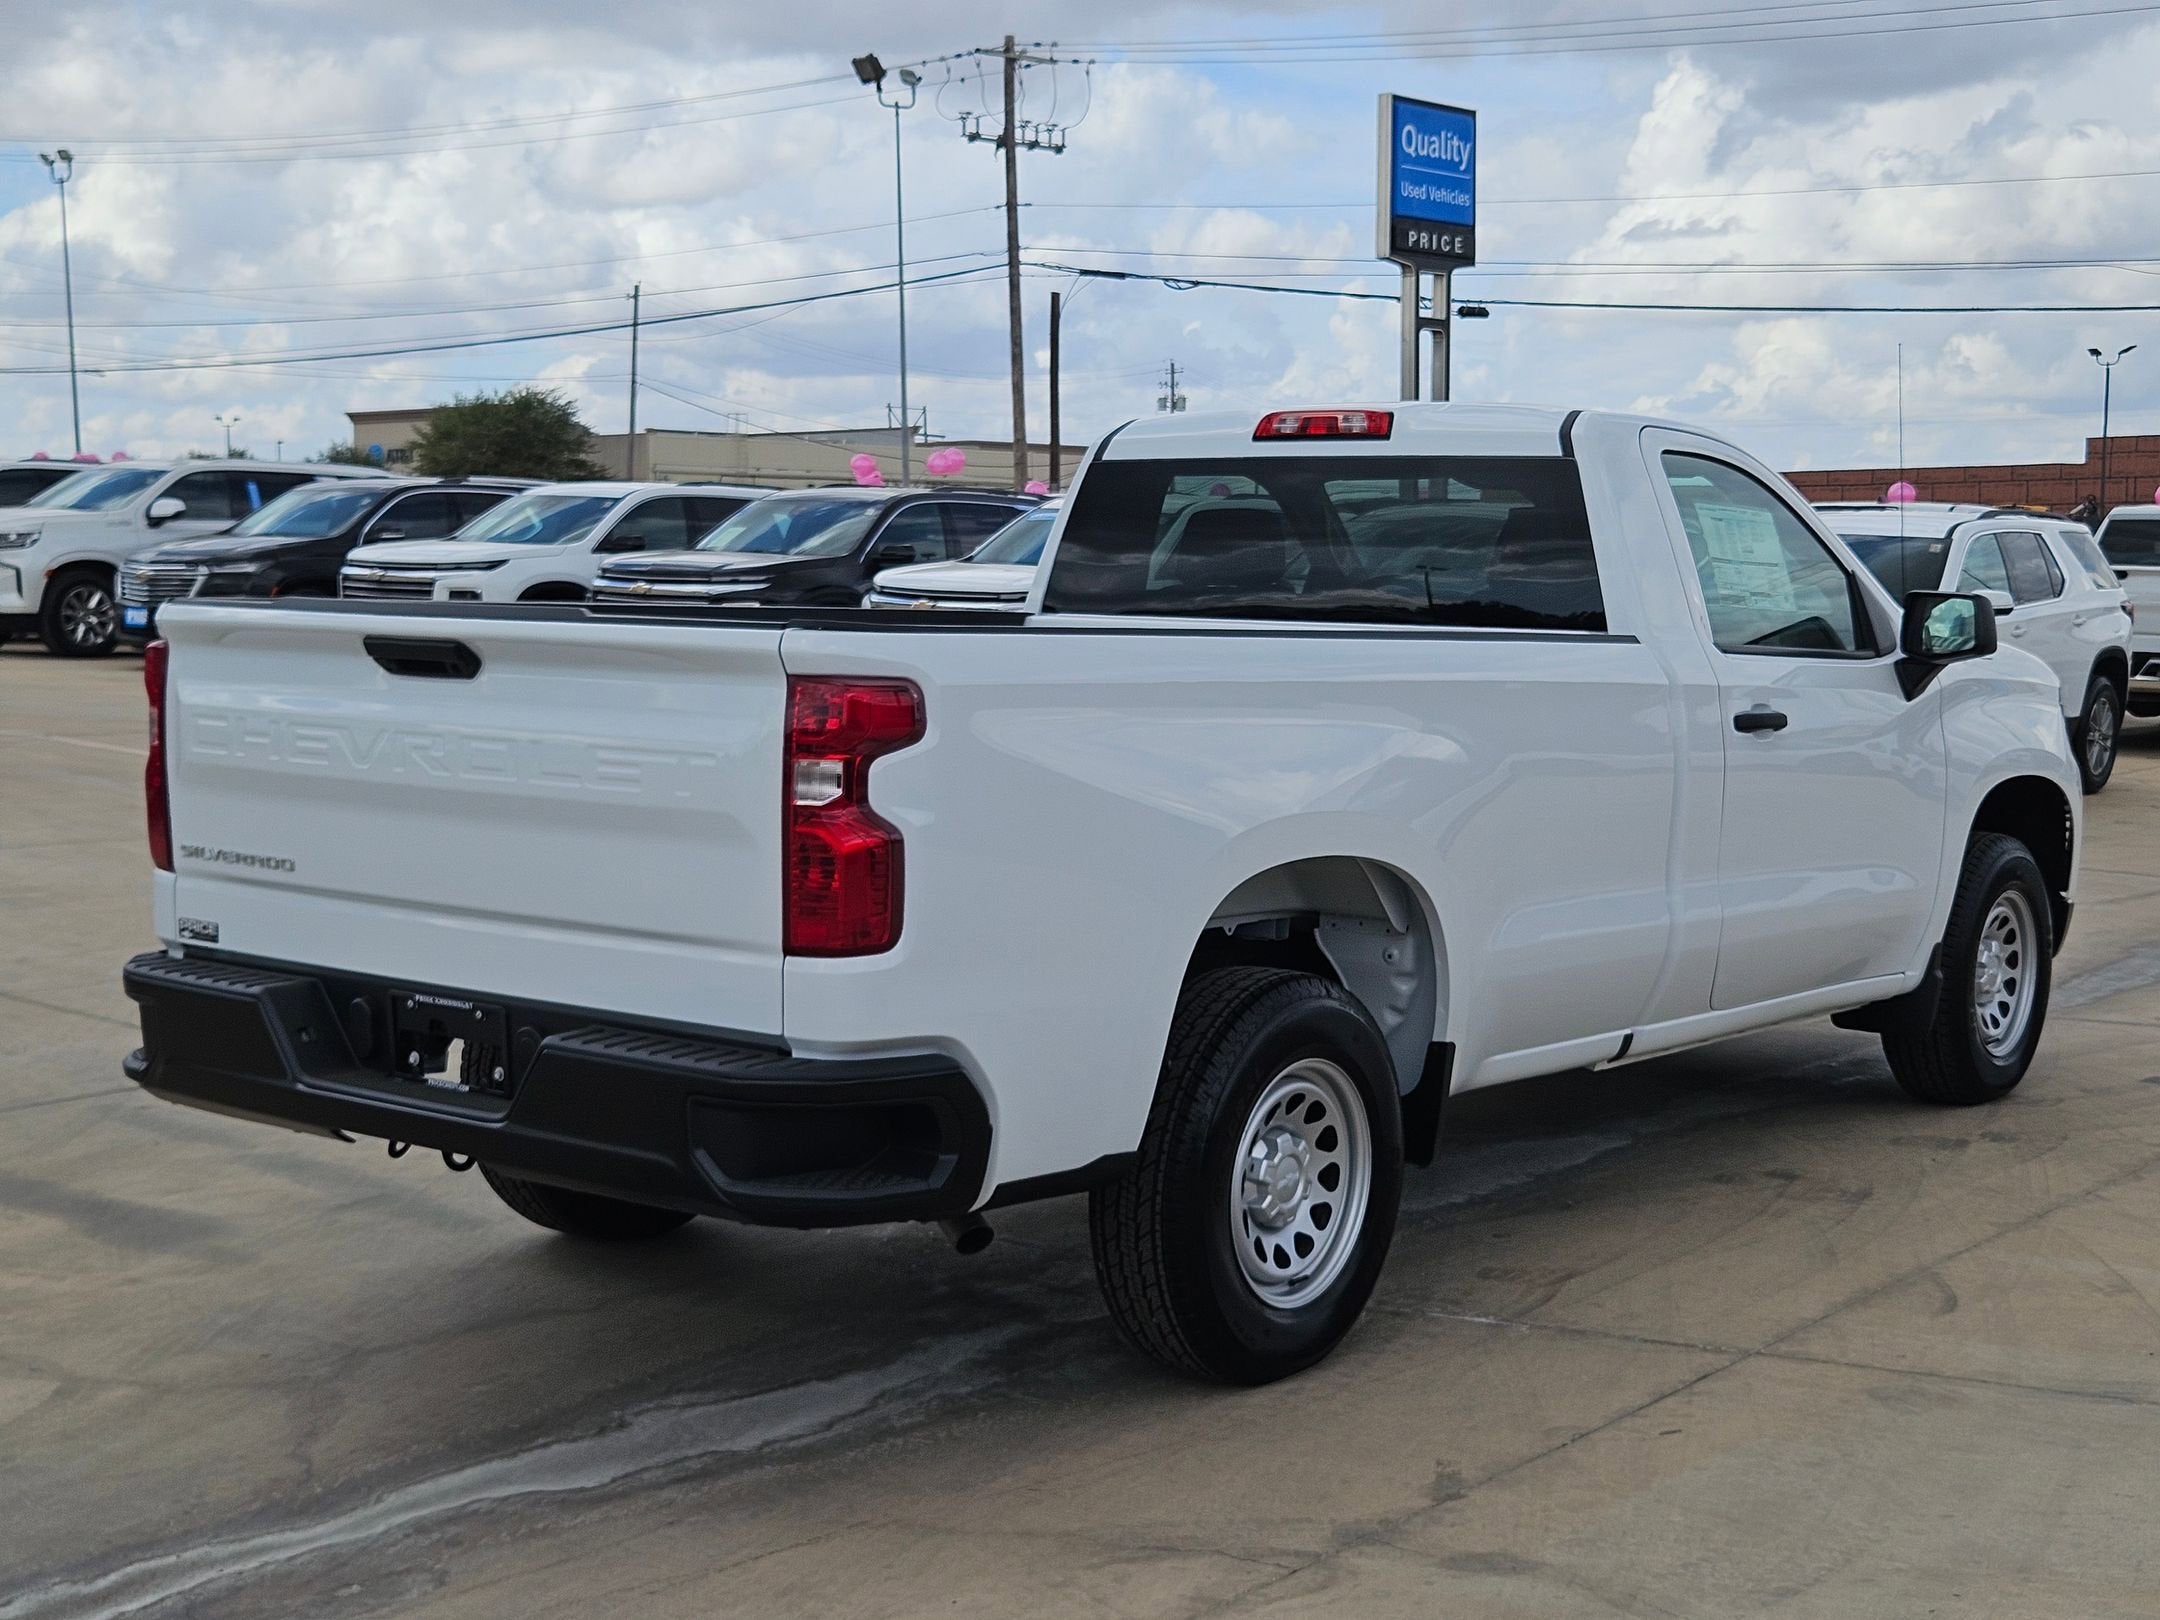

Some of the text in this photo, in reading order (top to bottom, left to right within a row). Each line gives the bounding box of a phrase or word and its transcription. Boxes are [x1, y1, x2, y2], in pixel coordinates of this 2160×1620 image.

[1401, 124, 1471, 171] Quality
[1400, 181, 1470, 206] Used Vehicles
[1408, 230, 1464, 254] PRICE
[180, 845, 296, 872] SILVERADO
